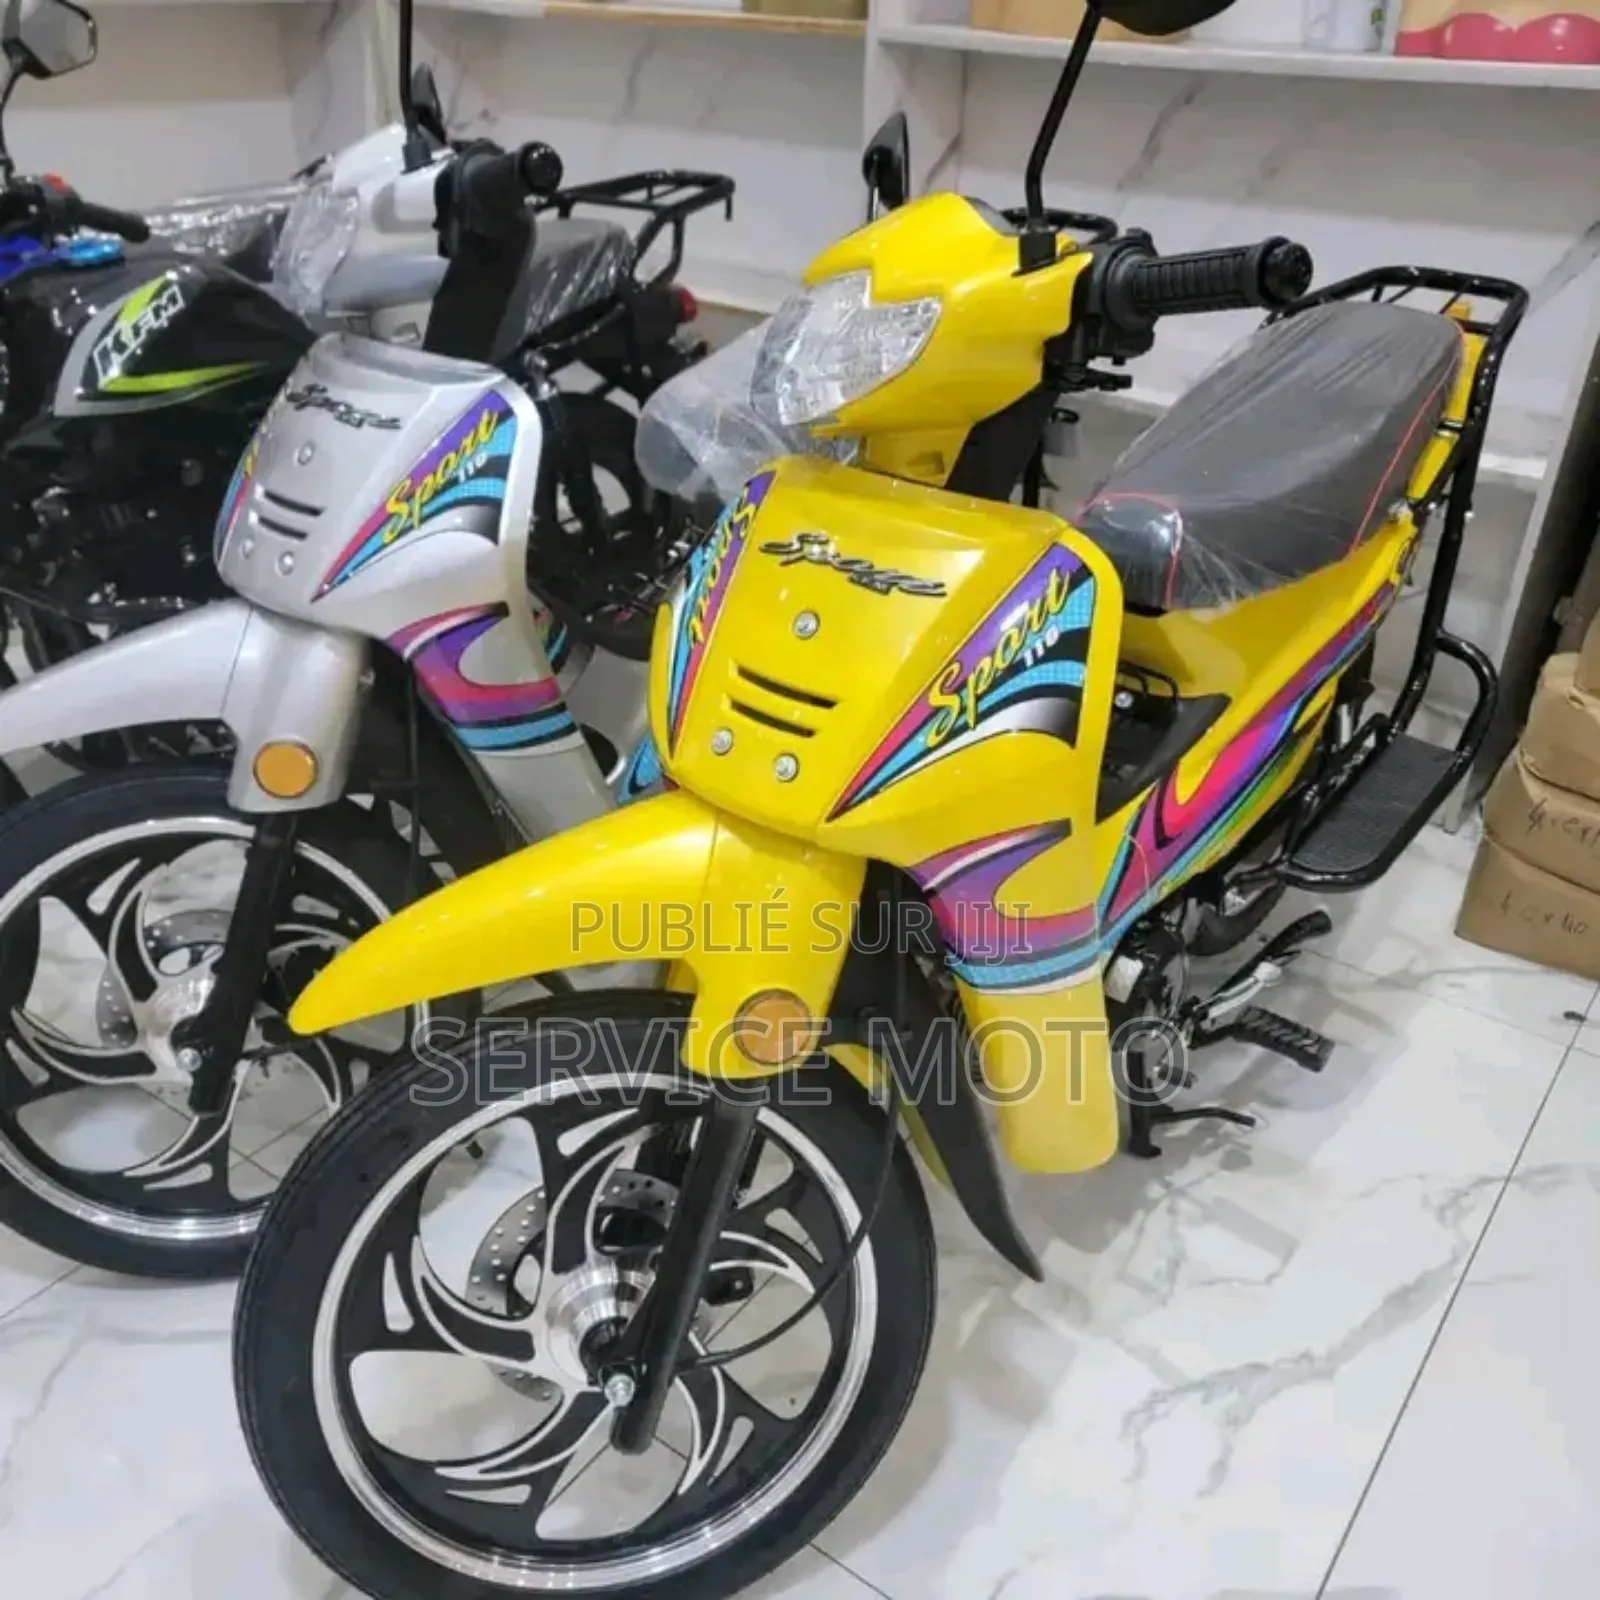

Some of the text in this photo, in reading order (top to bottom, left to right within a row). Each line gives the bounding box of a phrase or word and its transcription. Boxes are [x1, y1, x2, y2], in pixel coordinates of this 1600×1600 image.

[382, 407, 499, 545] Sport
[925, 566, 1071, 748] Sport
[1023, 623, 1061, 667] 110
